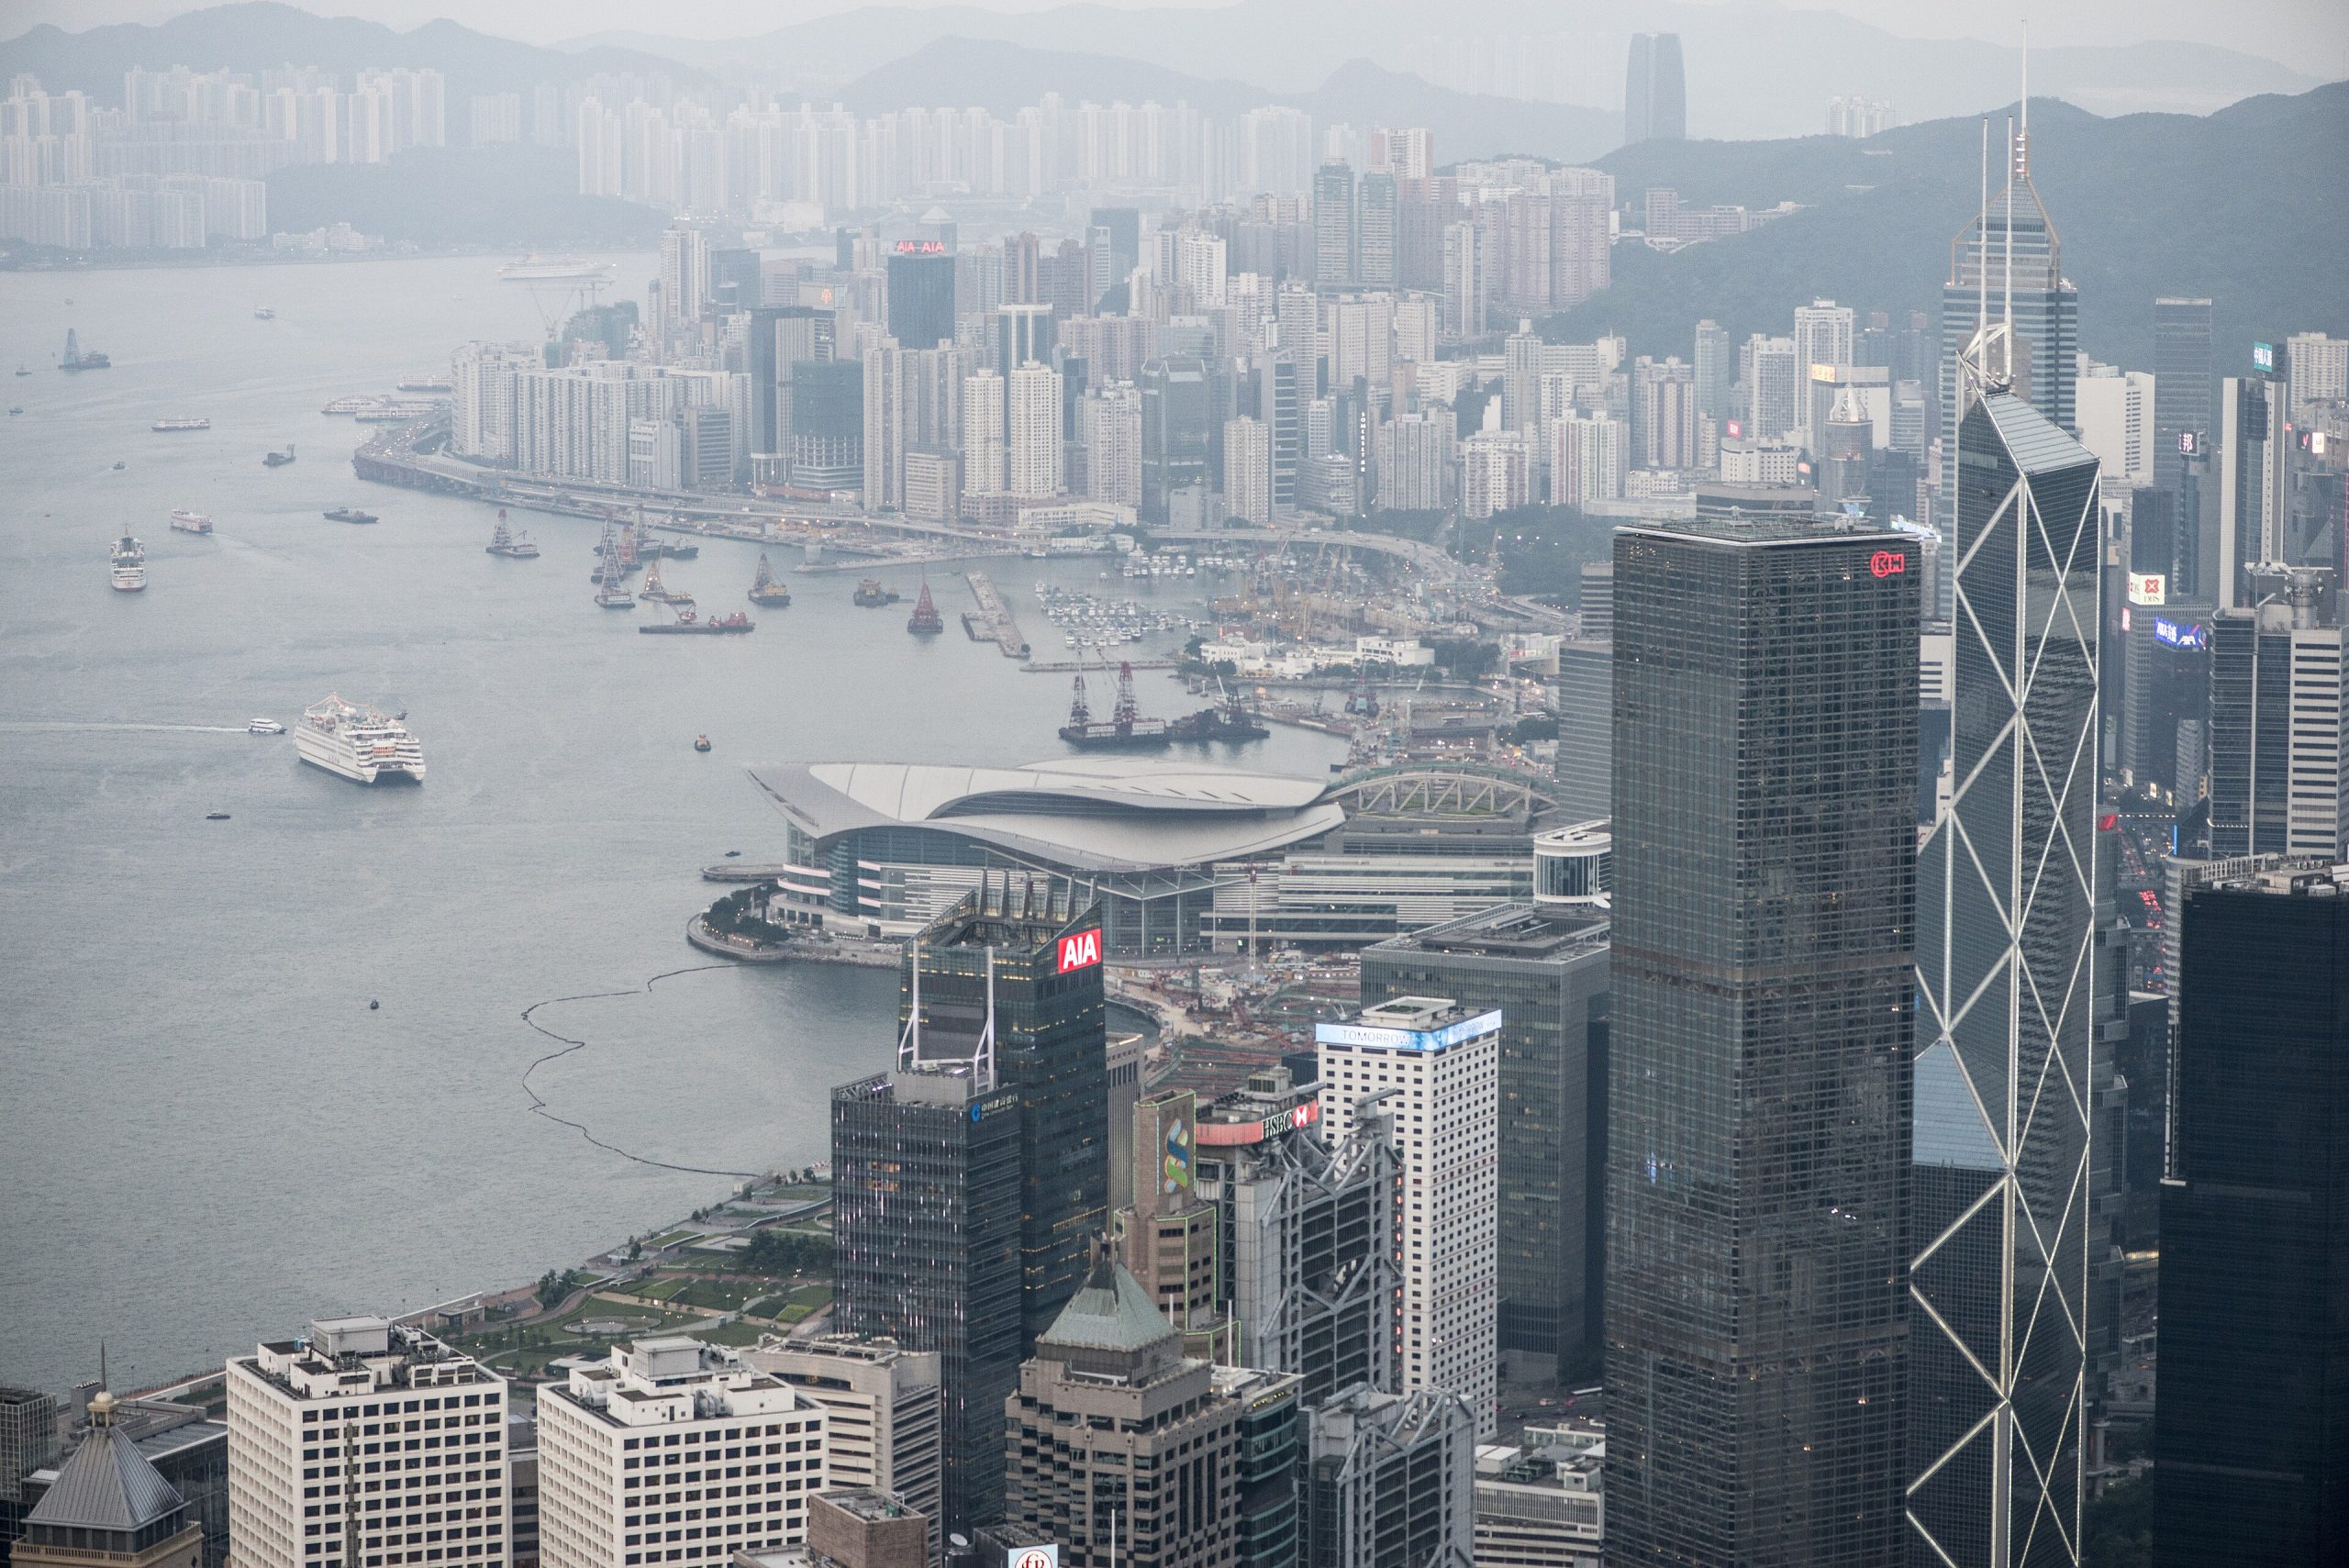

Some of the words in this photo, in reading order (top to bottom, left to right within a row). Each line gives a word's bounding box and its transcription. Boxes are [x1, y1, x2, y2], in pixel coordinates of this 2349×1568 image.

[896, 241, 915, 252] AIA
[921, 241, 944, 253] AIA
[1063, 933, 1097, 970] AIA
[1342, 1029, 1410, 1045] TOMORROW
[1261, 1109, 1293, 1140] HSBC
